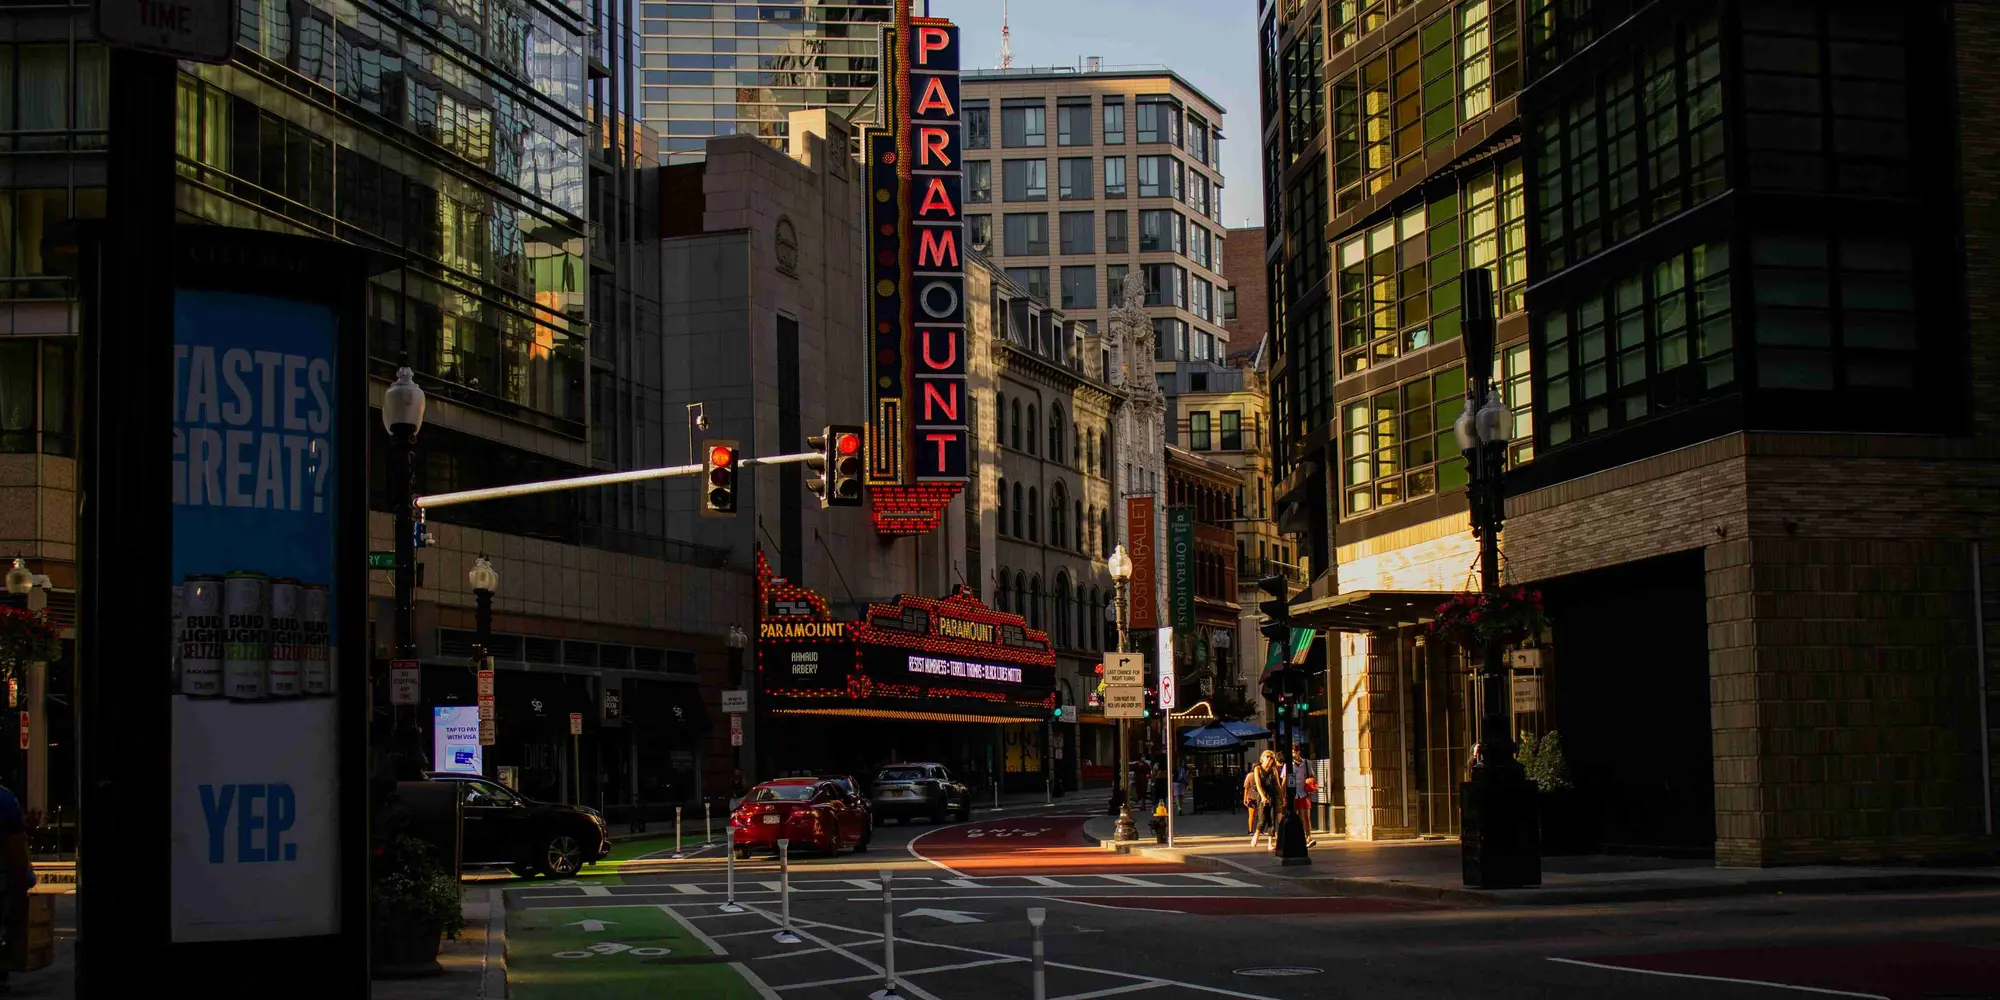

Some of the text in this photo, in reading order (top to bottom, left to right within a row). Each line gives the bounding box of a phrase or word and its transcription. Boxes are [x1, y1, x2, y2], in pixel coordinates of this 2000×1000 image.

[138, 0, 192, 34] TIME
[917, 27, 959, 473] PARAMOUNT
[173, 344, 332, 434] TASTES
[1175, 542, 1188, 629] OPERA HOUSE
[187, 616, 223, 629] BUD
[229, 615, 264, 629] BUD
[270, 618, 299, 631] BUD
[760, 622, 845, 638] PARAMOUNT
[939, 616, 994, 643] PARAMOUNT
[791, 652, 818, 662] AHMAUD
[909, 656, 924, 672] RESIST
[792, 664, 818, 675] ARBERY
[198, 785, 297, 864] YEP.
